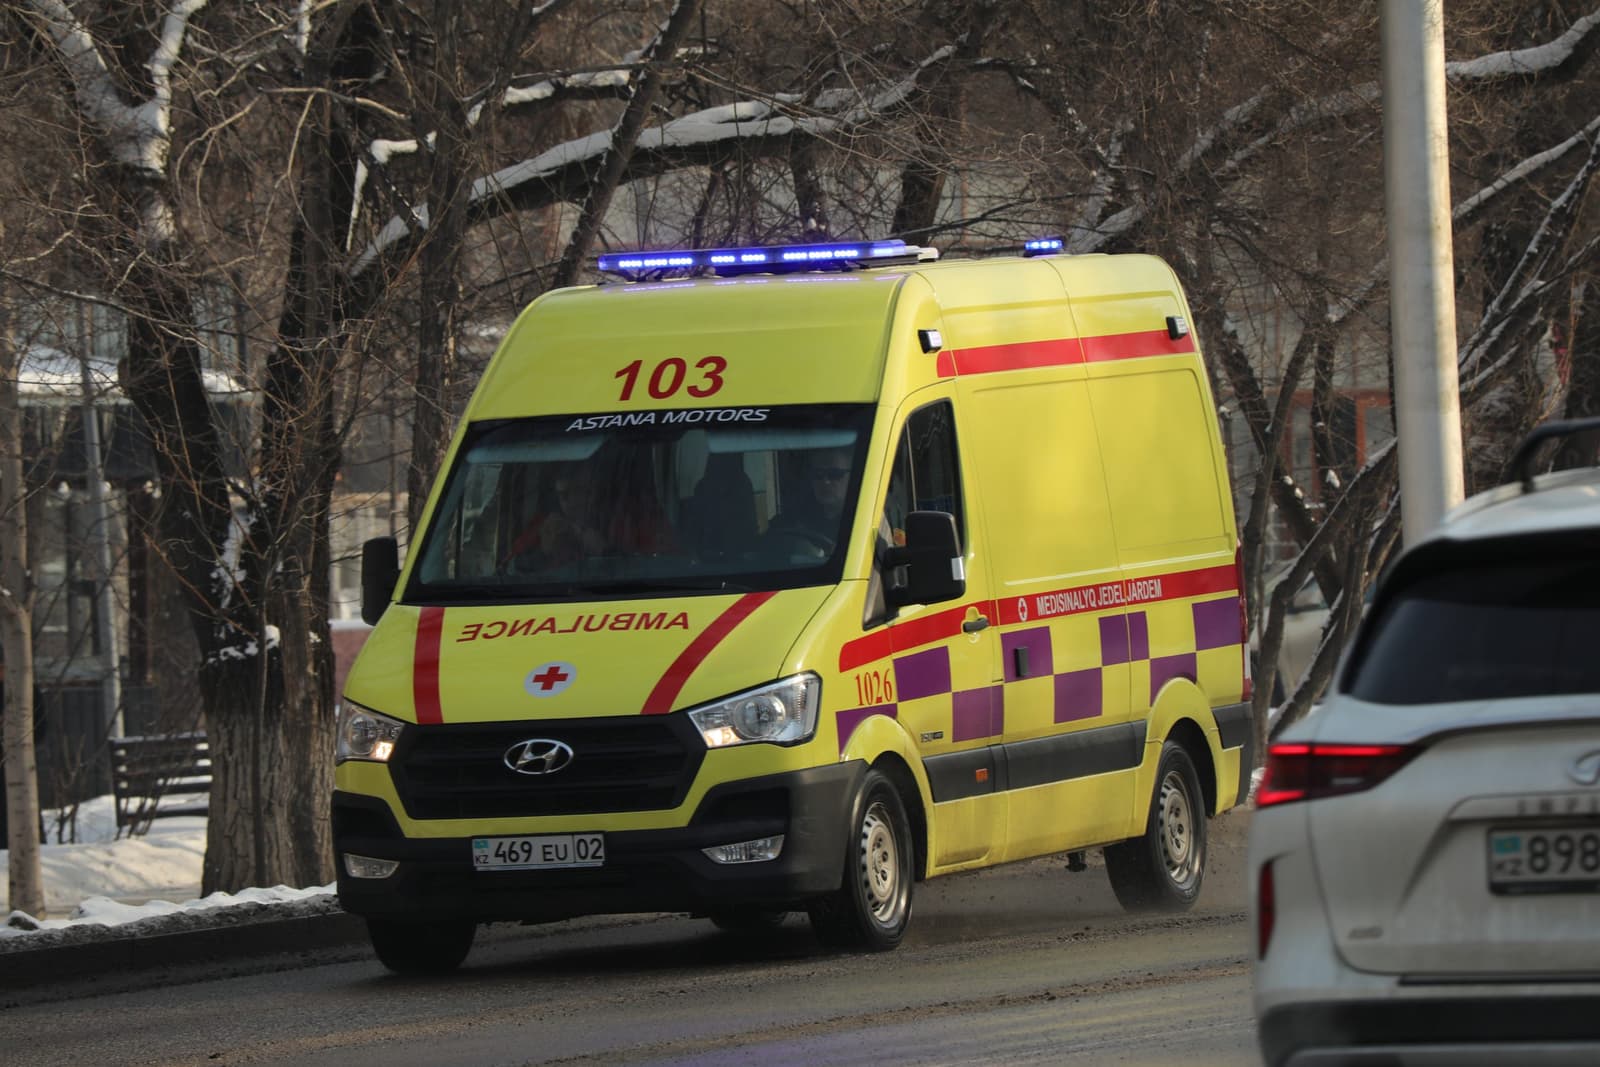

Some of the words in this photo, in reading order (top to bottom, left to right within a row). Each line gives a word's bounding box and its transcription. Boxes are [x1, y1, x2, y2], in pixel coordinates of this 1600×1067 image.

[614, 356, 727, 401] 103
[566, 412, 656, 432] ASTANA
[662, 409, 771, 424] MOTORS
[1036, 588, 1097, 616] MEDISINALYQ
[1098, 584, 1126, 605] JEDEL
[855, 668, 893, 706] 1026
[474, 855, 489, 865] KZ
[494, 841, 533, 863] 469
[542, 844, 568, 862] EU
[576, 838, 603, 861] 02
[1528, 832, 1600, 875] 898
